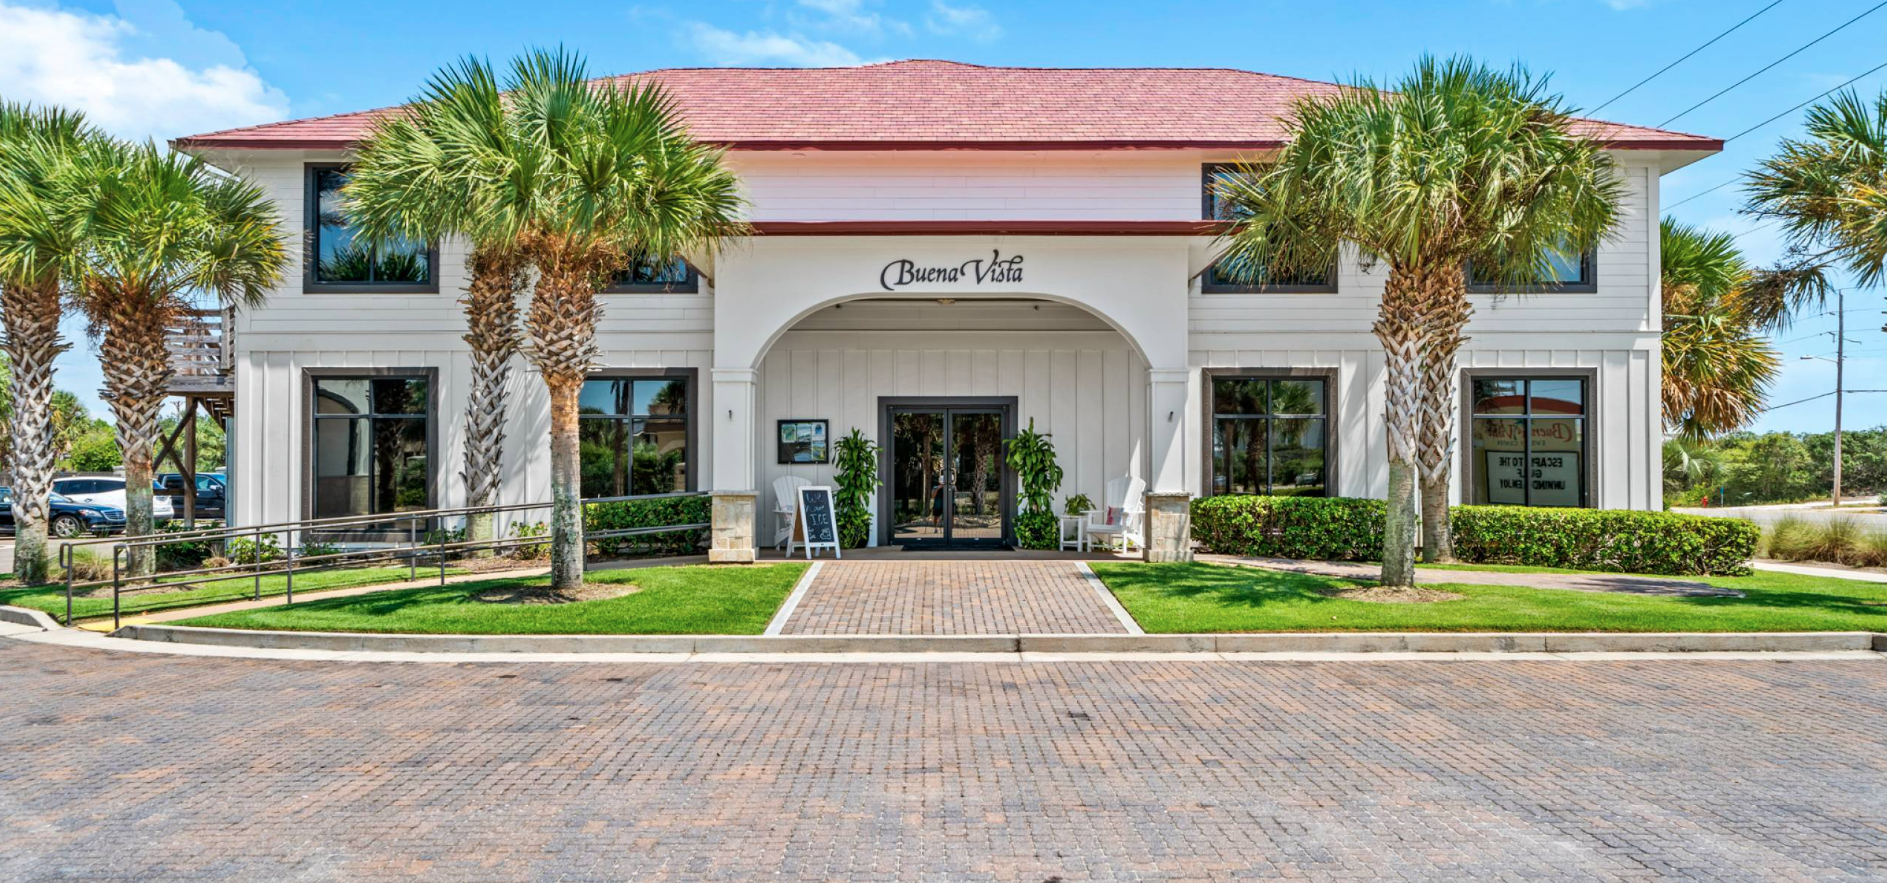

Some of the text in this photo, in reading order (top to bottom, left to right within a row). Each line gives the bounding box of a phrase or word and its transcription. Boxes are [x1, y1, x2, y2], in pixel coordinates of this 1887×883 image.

[880, 249, 1024, 291] Buena Vista
[810, 513, 829, 526] ICE
